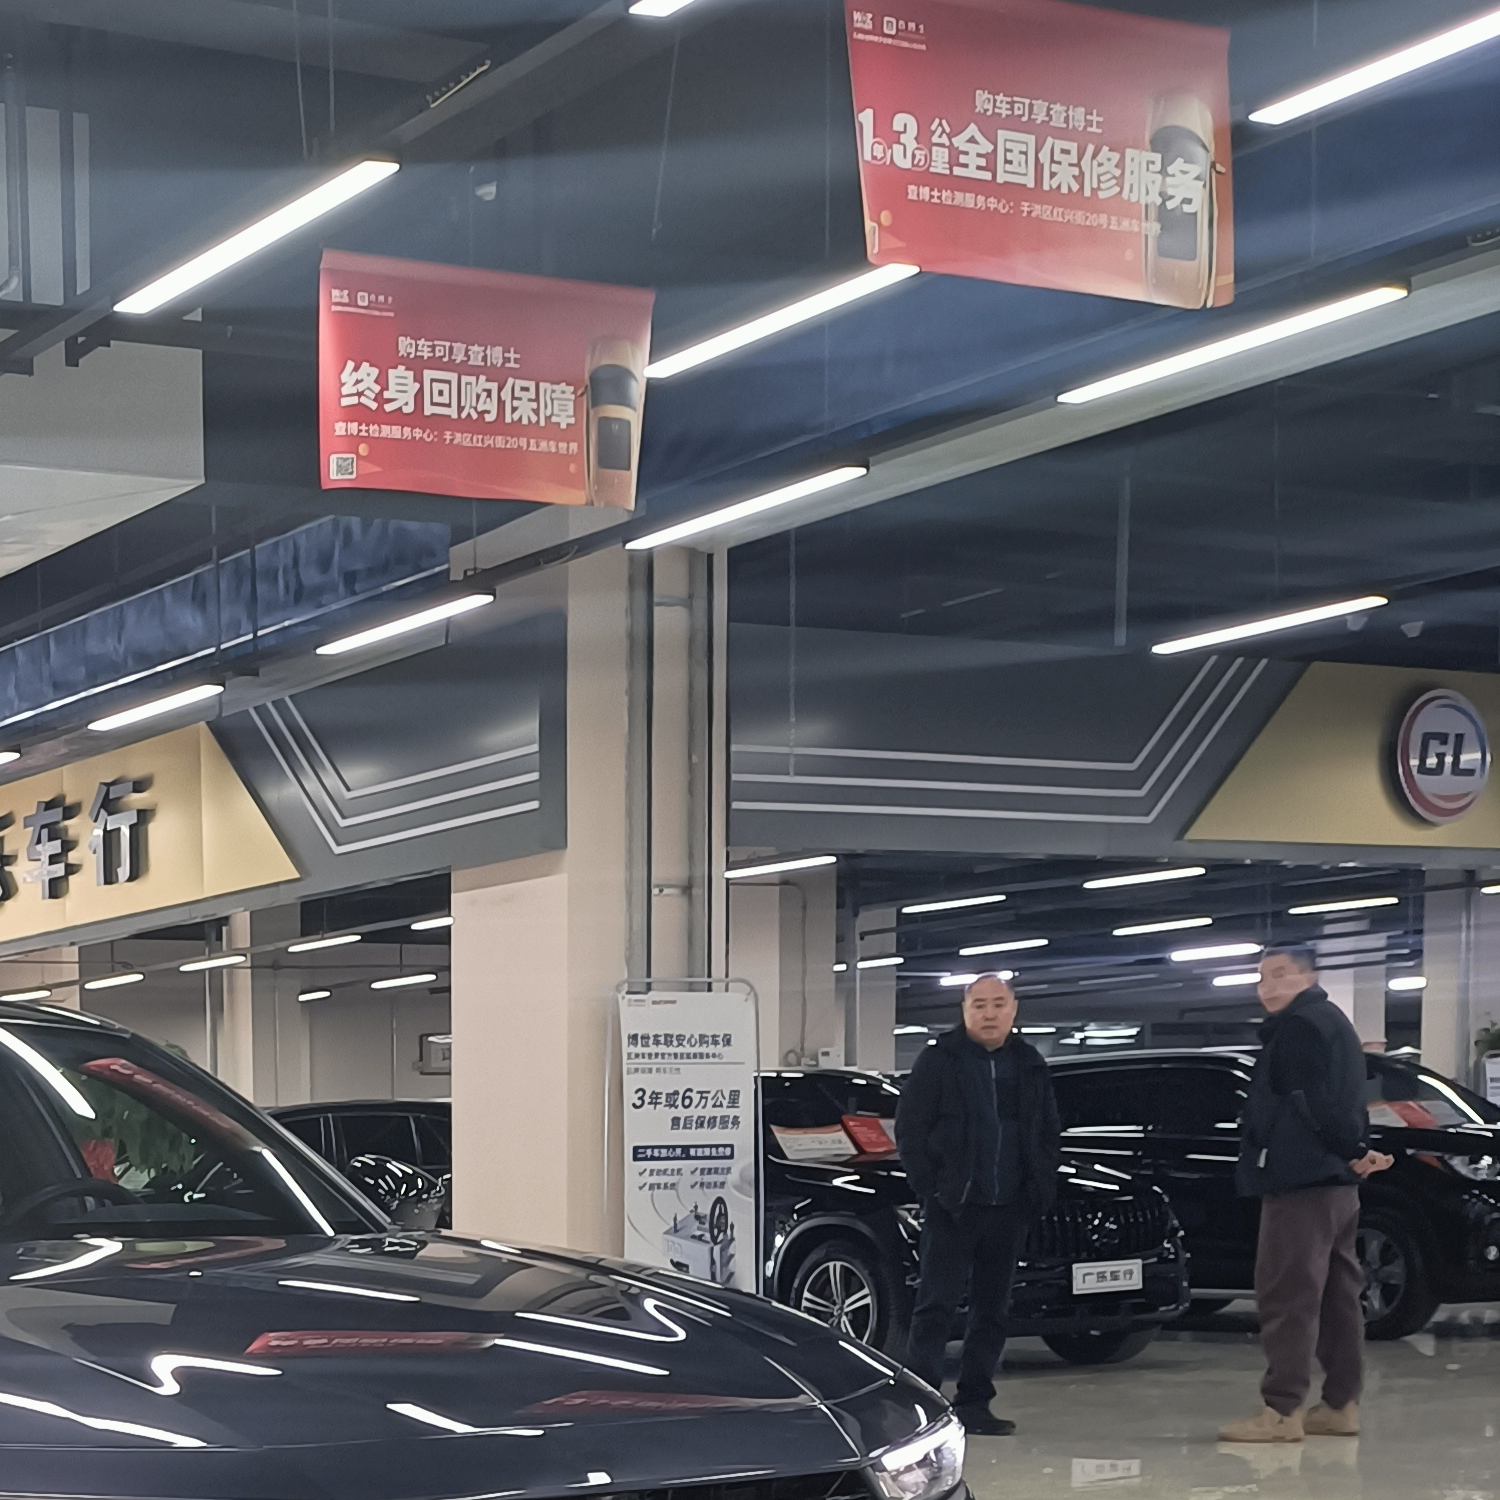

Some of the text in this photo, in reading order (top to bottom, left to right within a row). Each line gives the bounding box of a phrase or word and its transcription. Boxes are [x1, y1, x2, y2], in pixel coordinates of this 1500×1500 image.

[975, 89, 1104, 134] 购车可享查博士
[398, 336, 521, 369] 购车可享查博士
[339, 360, 577, 430] 终身回购保障
[1416, 730, 1477, 777] GL
[631, 1087, 742, 1111] 3年或6万公里
